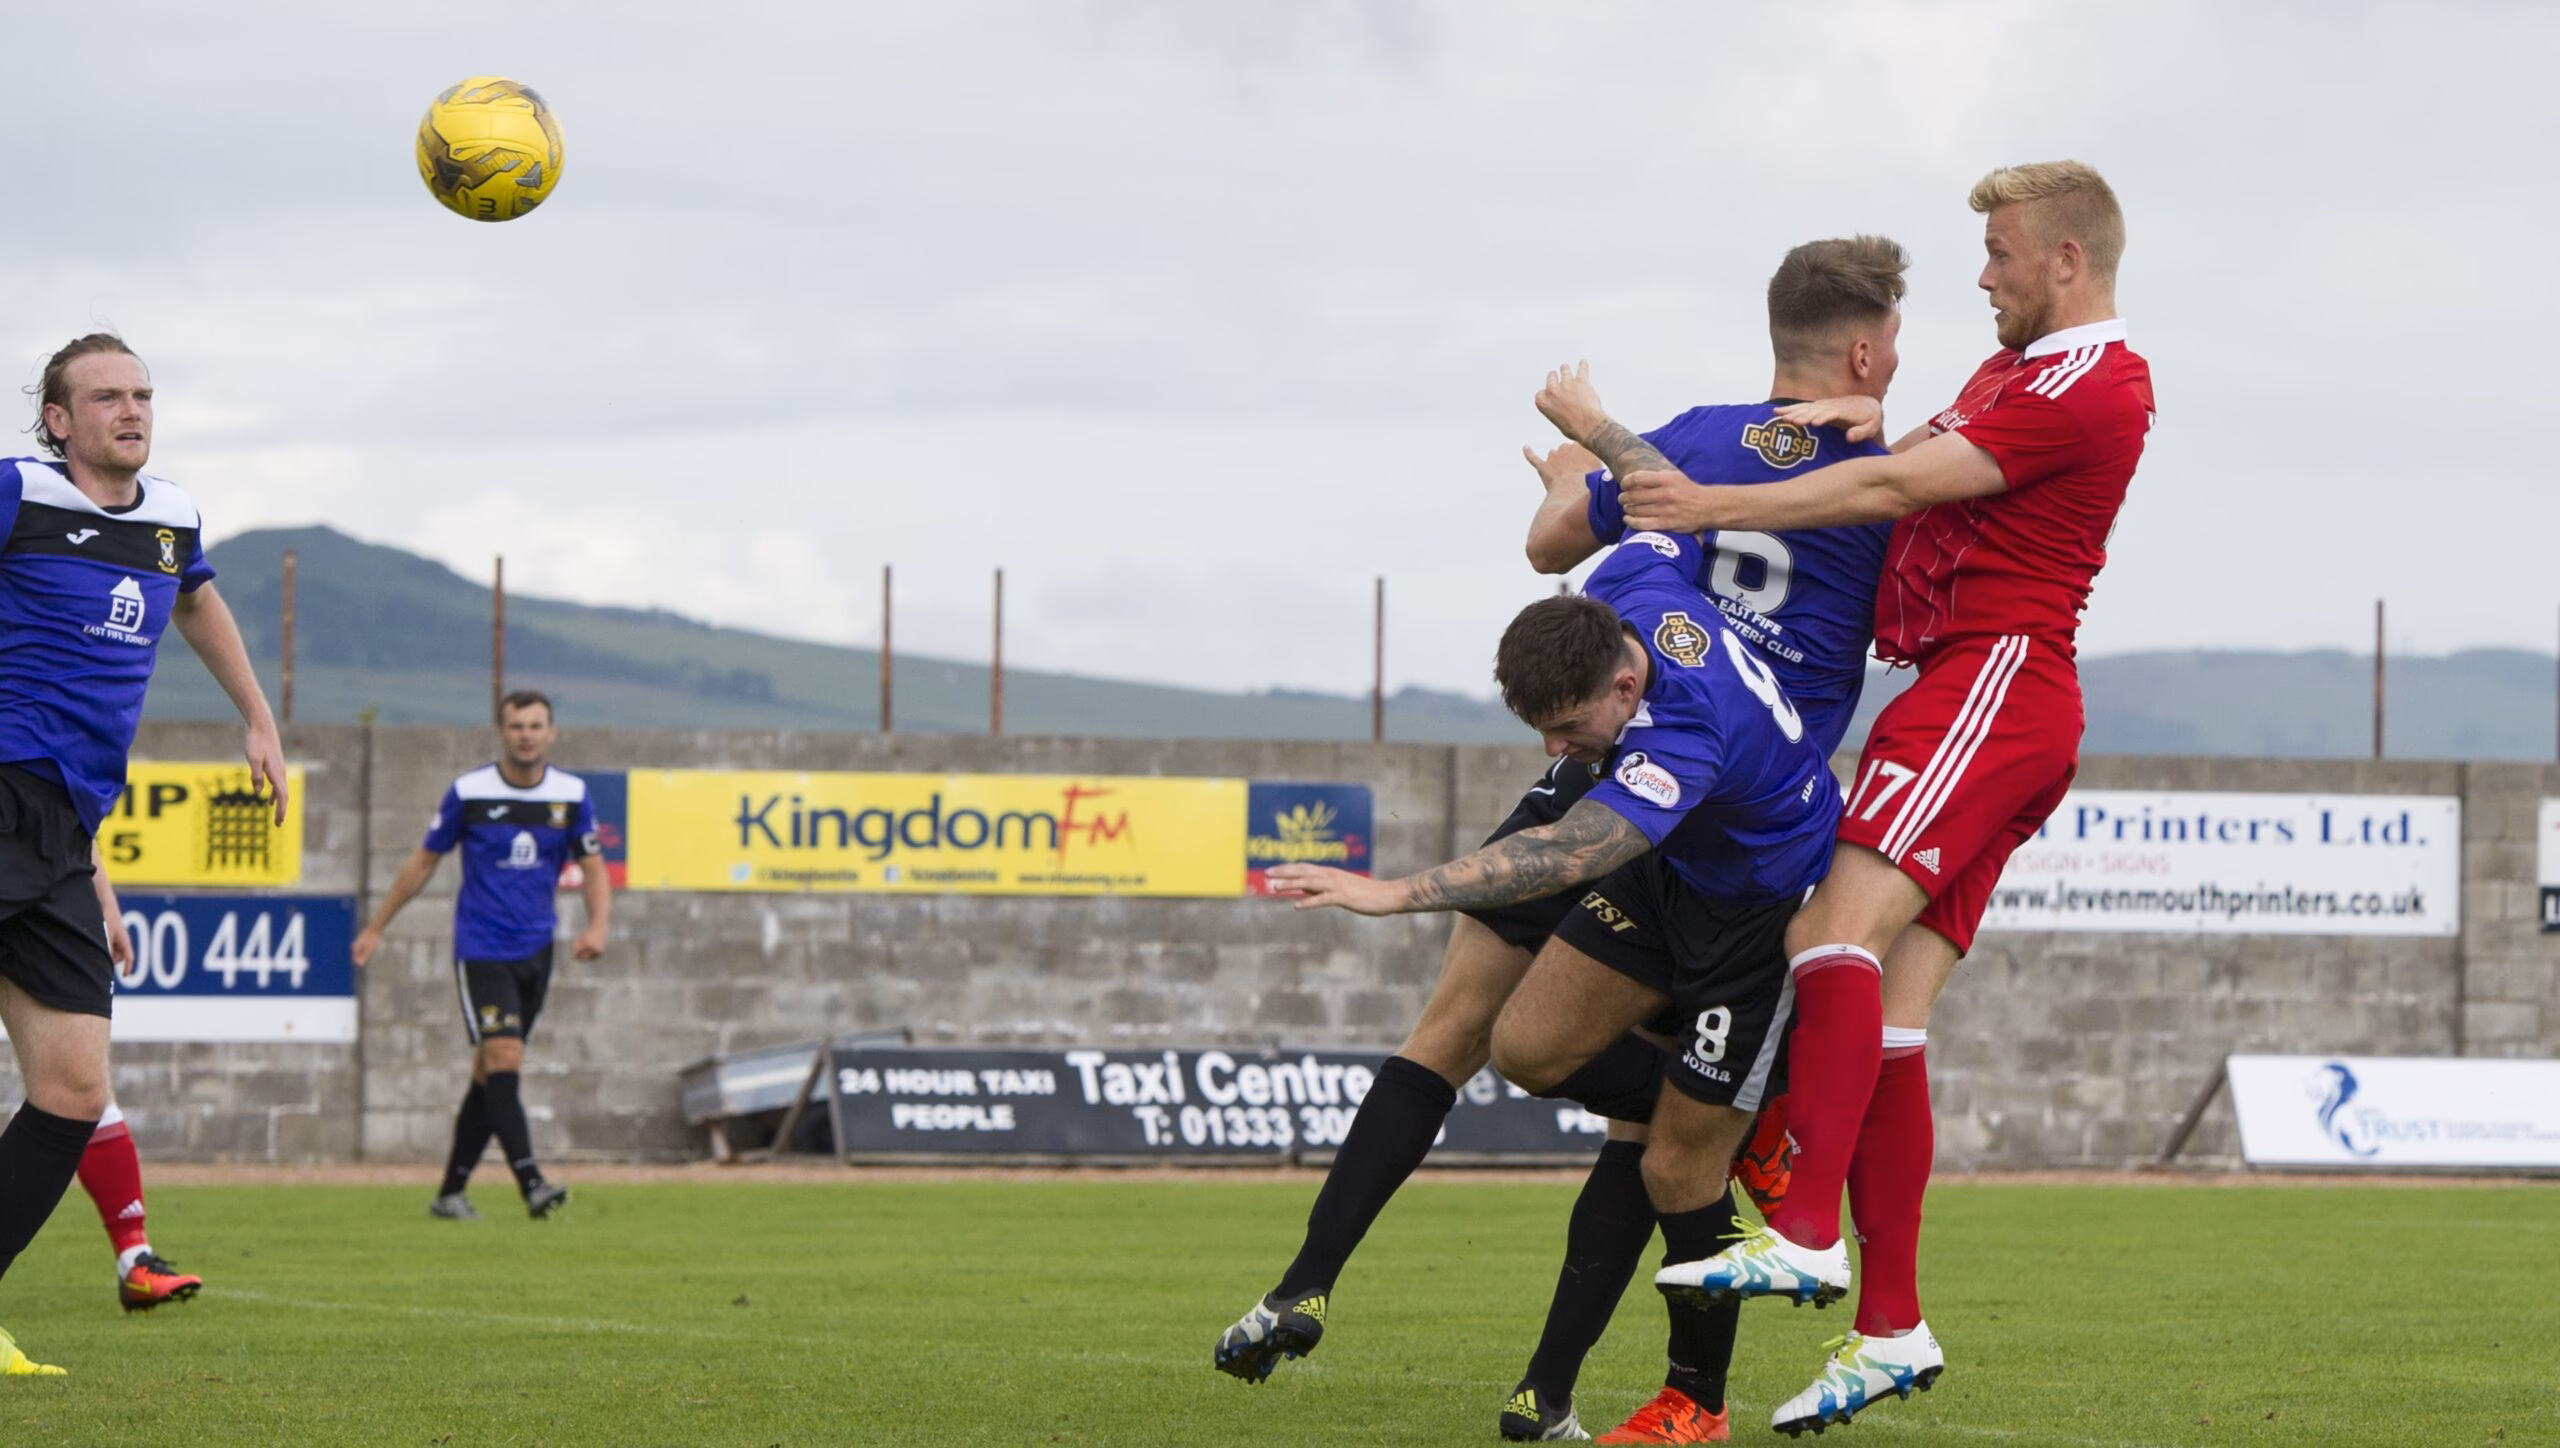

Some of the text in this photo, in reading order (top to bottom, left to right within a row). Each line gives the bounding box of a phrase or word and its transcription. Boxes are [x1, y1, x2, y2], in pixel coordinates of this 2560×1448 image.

[1748, 427, 1812, 457] eclipse
[83, 625, 105, 637] EAST
[1719, 598, 1752, 620] EAST
[1751, 612, 1783, 636] FIFE
[1668, 617, 1698, 665] eclipse
[1767, 640, 1804, 663] CLUB
[1720, 627, 1803, 743] 8
[1845, 758, 1920, 822] 17
[2075, 806, 2296, 845] Printers
[2319, 809, 2429, 847] Ltd.
[1912, 852, 1941, 875] adidas
[2007, 854, 2081, 874] ESIGN
[1580, 891, 1637, 932] EFST
[203, 911, 310, 989] 444
[1695, 1005, 1732, 1063] 8
[839, 1068, 1056, 1096] 24 HOUR TAXI
[1066, 1050, 1375, 1107] Taxi Centre
[892, 1103, 1016, 1131] PEOPLE
[1133, 1105, 1174, 1146] T:
[1180, 1105, 1295, 1147] 01333
[1503, 1403, 1540, 1422] adidas
